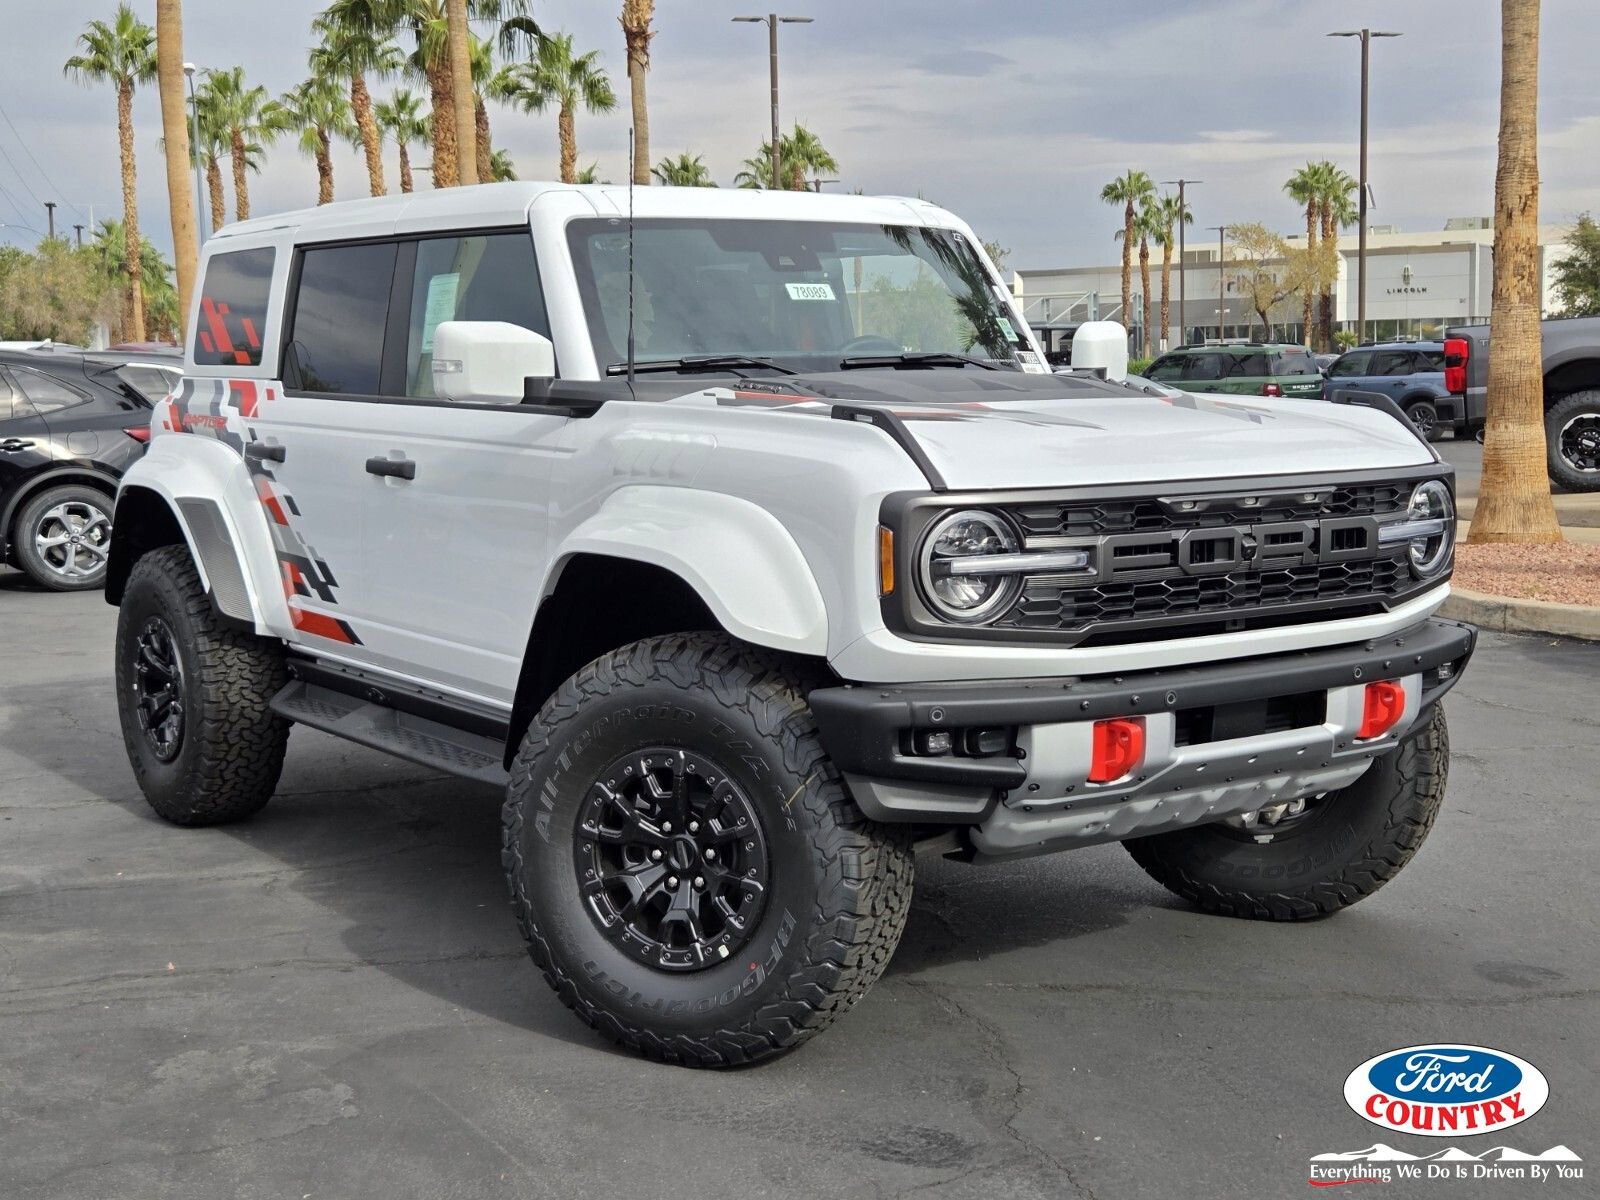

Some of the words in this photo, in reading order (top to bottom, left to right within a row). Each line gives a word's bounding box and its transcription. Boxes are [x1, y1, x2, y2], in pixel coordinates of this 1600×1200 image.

[792, 286, 828, 299] 78089
[183, 413, 228, 429] RAPTOR
[1098, 518, 1378, 582] FORD
[534, 702, 696, 843] All-Terrain
[583, 908, 796, 1016] BFGoodrich
